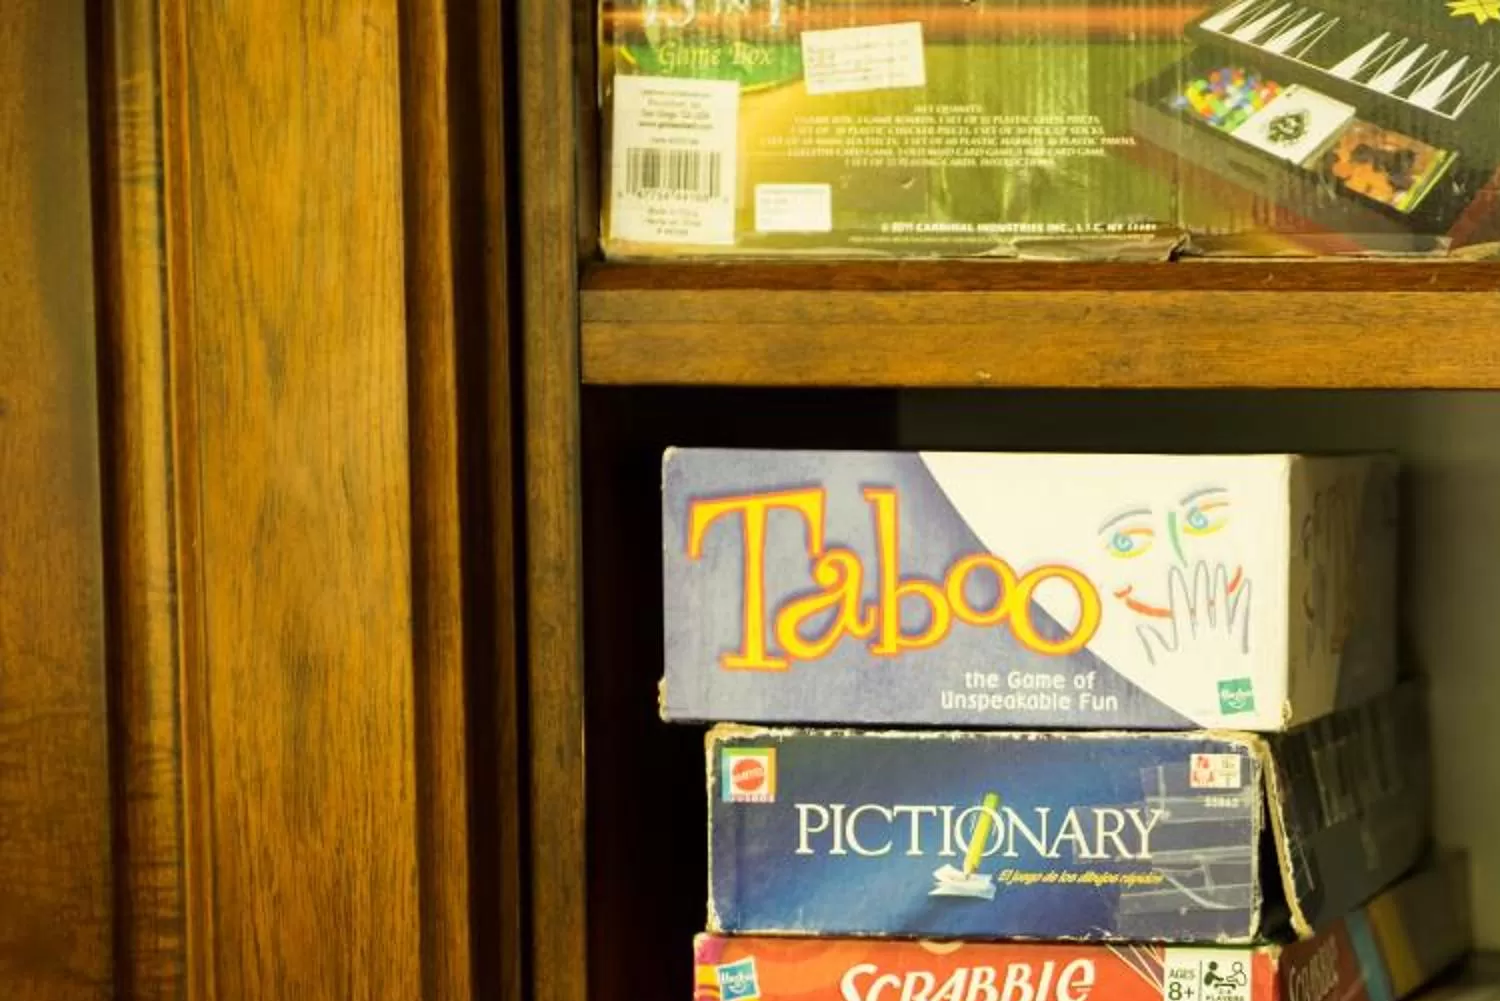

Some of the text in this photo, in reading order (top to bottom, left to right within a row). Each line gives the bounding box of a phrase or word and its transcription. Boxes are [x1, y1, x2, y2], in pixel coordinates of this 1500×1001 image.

[686, 481, 1102, 671] Taboo
[964, 670, 1097, 689] the Game of
[941, 690, 1118, 712] Unspeakable Fun
[794, 801, 1166, 860] PICTIONARY
[1169, 968, 1196, 979] AGES
[1168, 981, 1195, 1001] 8+
